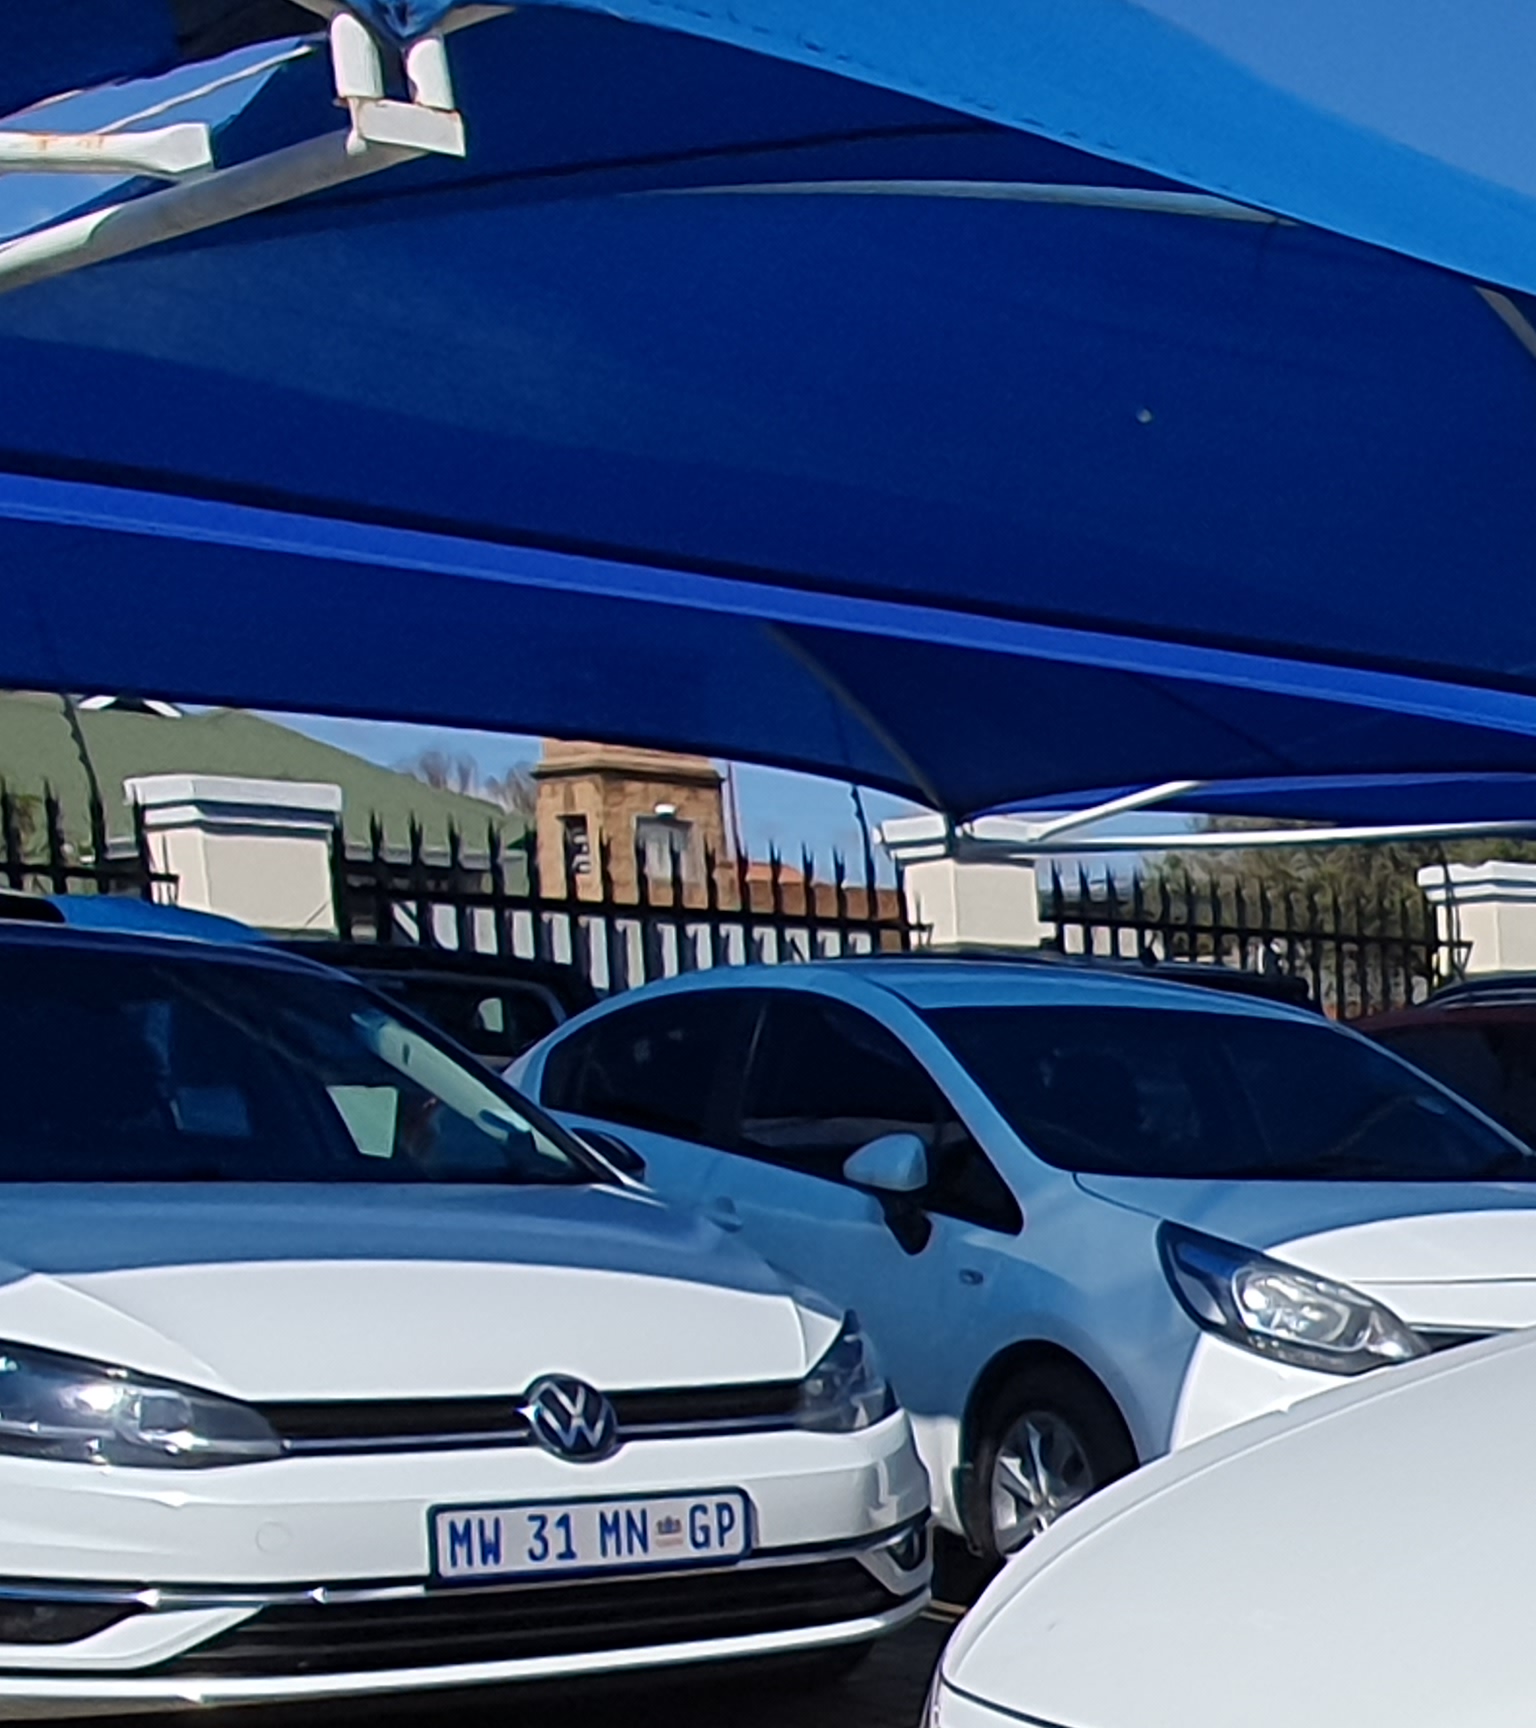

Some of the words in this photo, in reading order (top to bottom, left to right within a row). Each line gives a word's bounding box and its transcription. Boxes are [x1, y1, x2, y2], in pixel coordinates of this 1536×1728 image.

[449, 1517, 502, 1568] MW
[527, 1512, 577, 1562] 31
[599, 1507, 649, 1558] MN
[689, 1501, 735, 1550] GP
